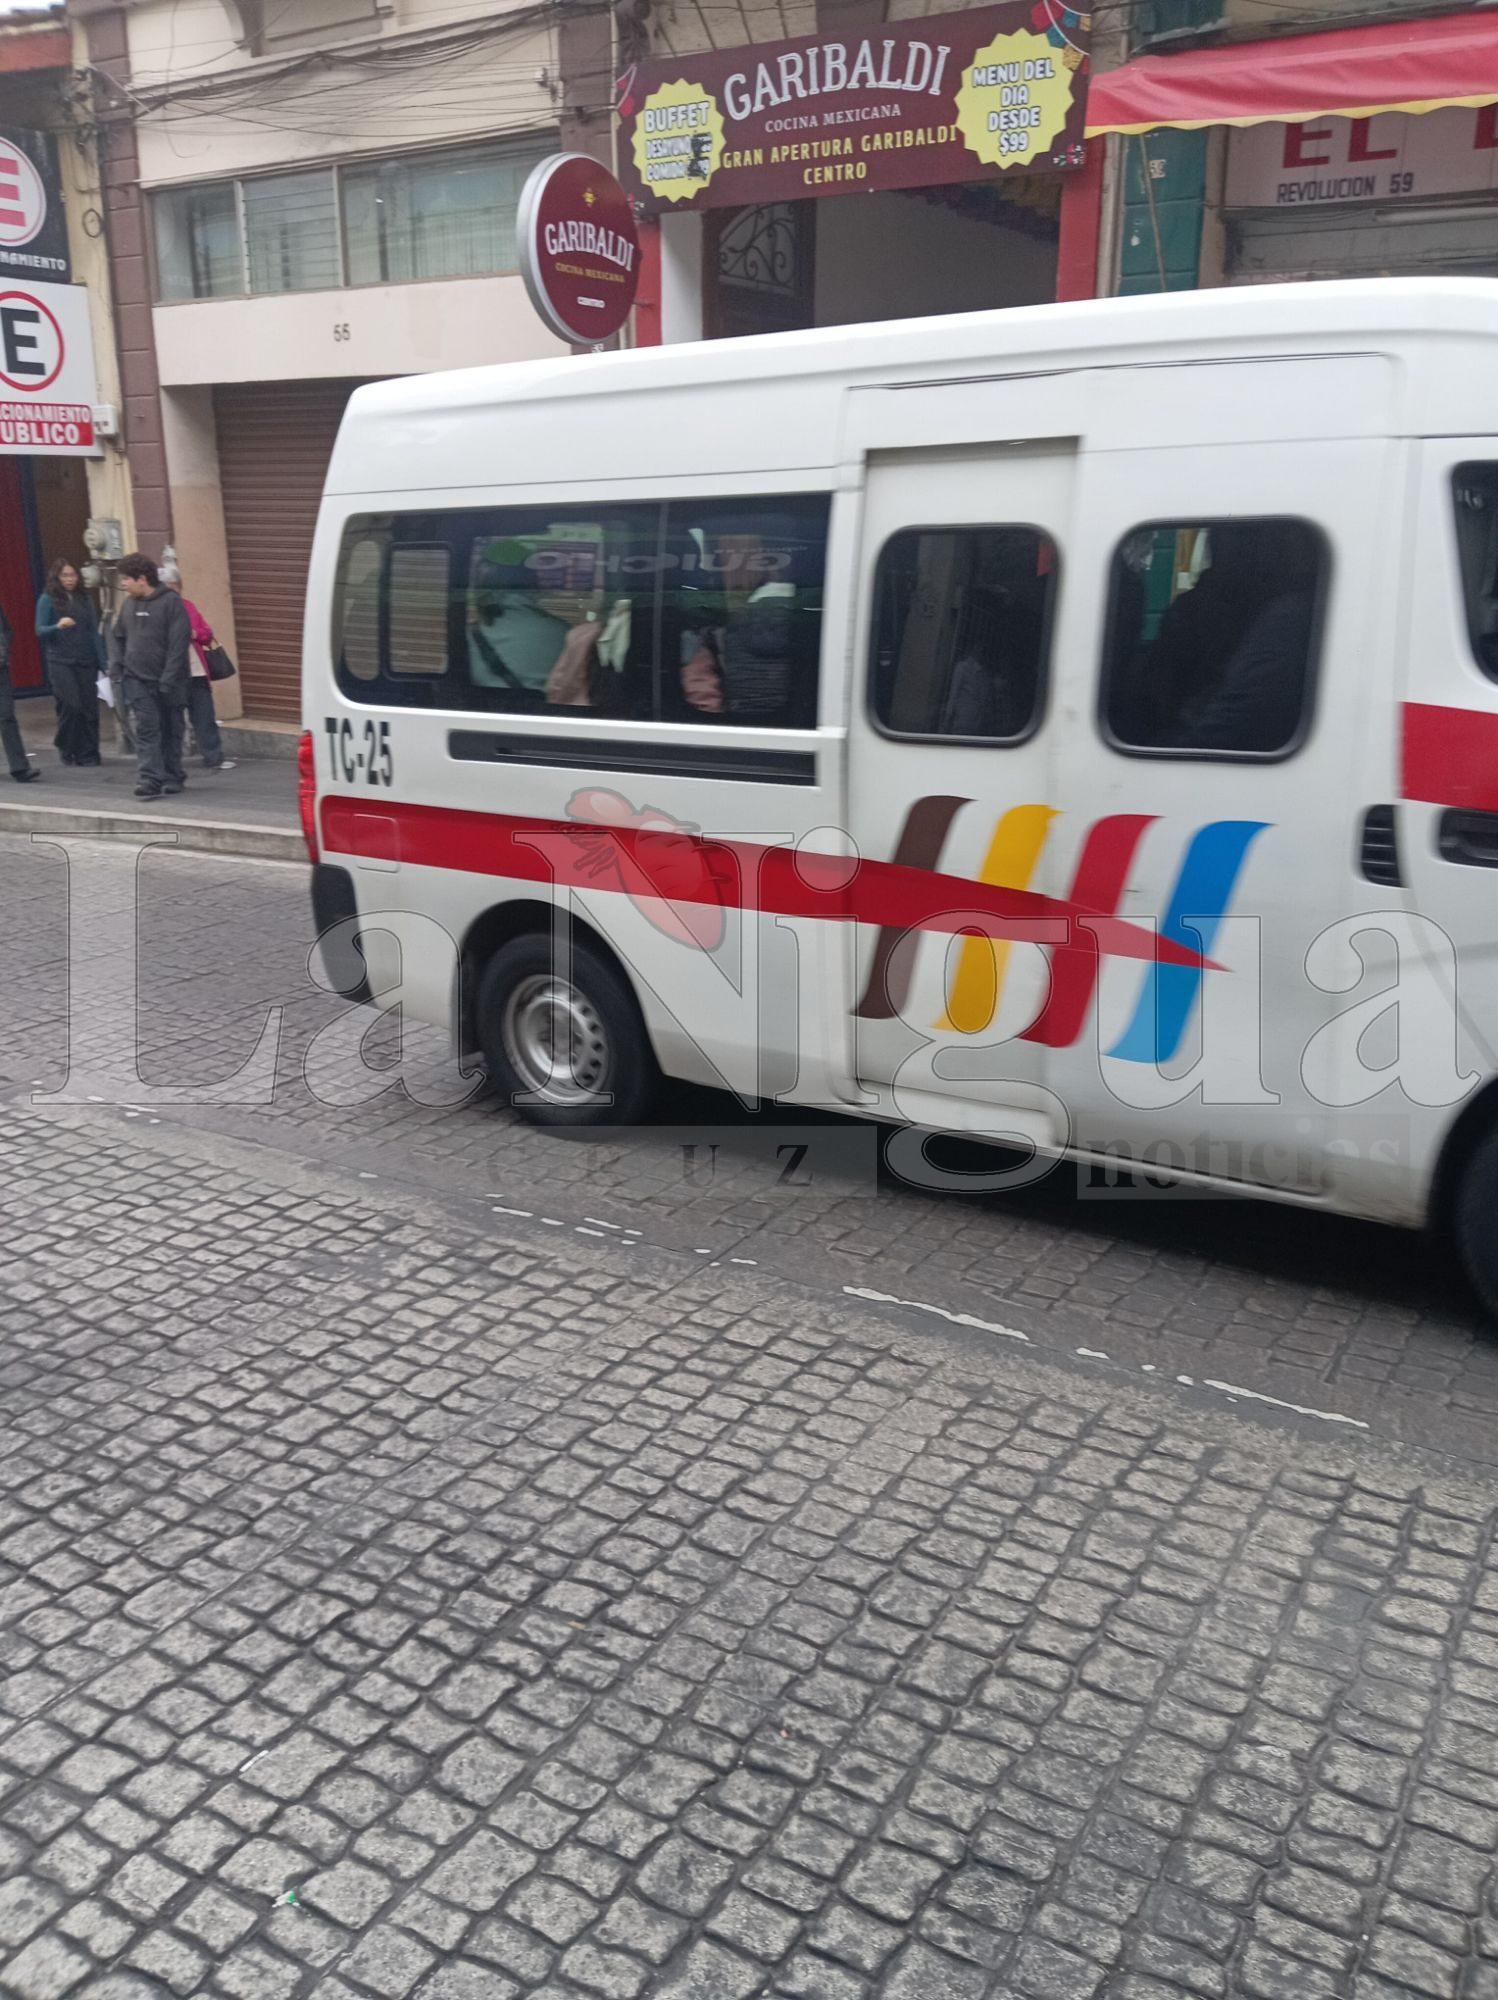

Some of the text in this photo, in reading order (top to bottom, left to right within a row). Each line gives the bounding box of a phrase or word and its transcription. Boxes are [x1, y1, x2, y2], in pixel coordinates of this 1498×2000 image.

[724, 39, 951, 121] GARIBALDI
[972, 57, 1055, 88] MENU DEL
[1001, 83, 1029, 107] DIA
[644, 101, 710, 133] BUFFET
[764, 103, 902, 134] COCINA MEXICANA
[987, 106, 1040, 132] DESDE
[723, 151, 763, 169] GRAN
[770, 140, 853, 164] APERTURA
[861, 124, 957, 152] GARIBALDI
[999, 131, 1029, 157] $99
[803, 162, 867, 185] CENTRO
[1277, 172, 1414, 204] REVOLUCION 59
[545, 220, 635, 271] GARIBALDI
[1, 307, 46, 376] E
[334, 324, 350, 342] 55
[324, 716, 394, 788] TC-25
